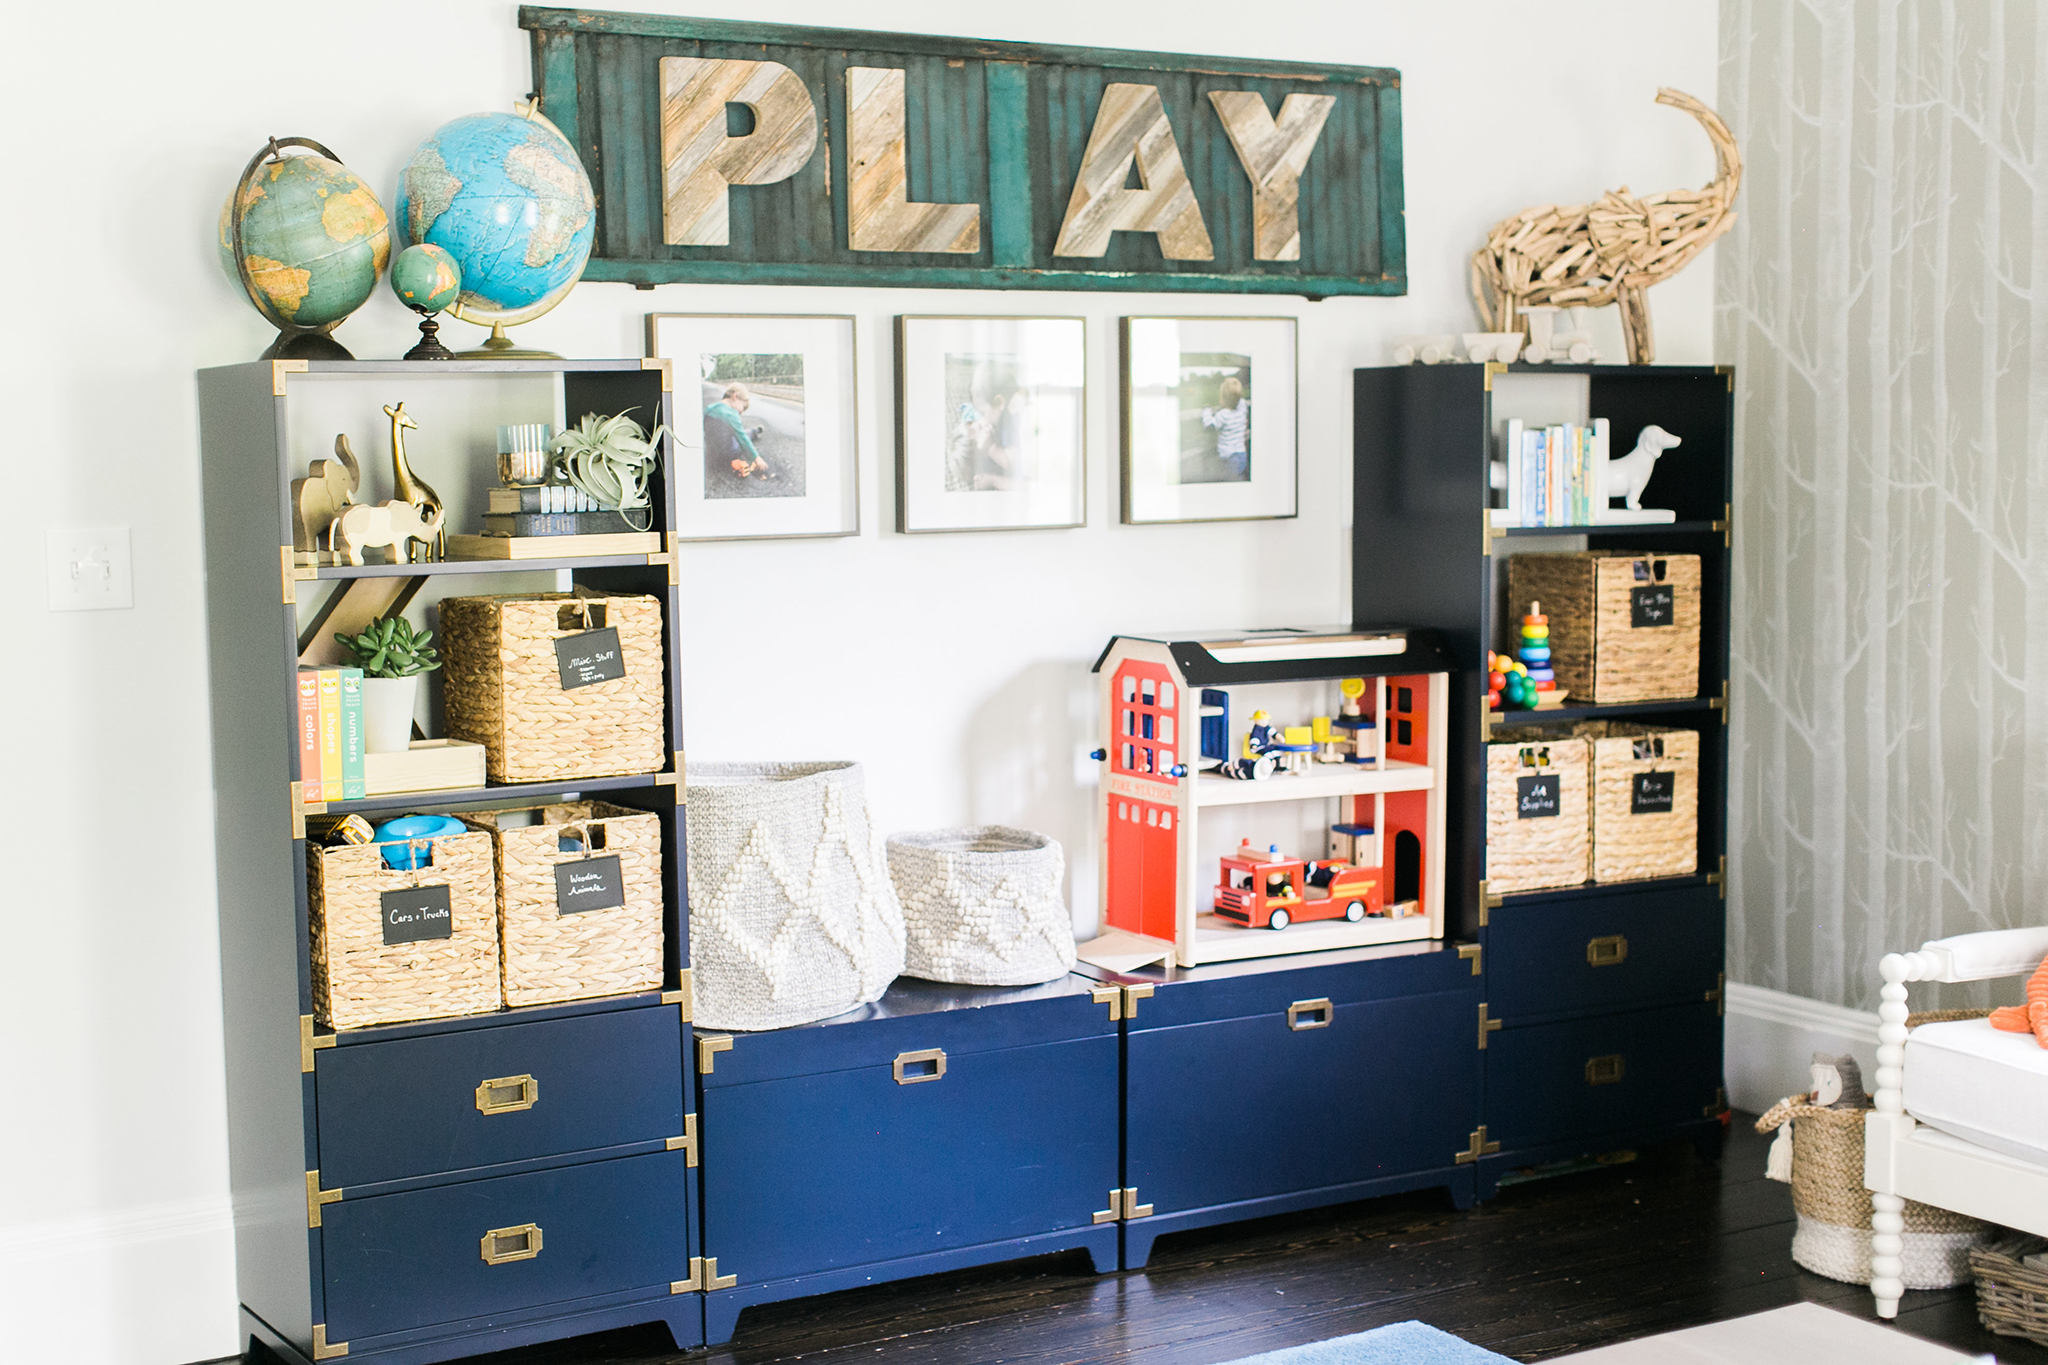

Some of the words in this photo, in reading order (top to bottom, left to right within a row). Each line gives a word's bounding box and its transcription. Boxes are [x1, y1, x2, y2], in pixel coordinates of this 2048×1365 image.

[659, 56, 1337, 260] PLAY
[305, 714, 316, 751] colors
[325, 712, 337, 754] shapes
[348, 711, 359, 763] numbers
[390, 909, 413, 925] Cars
[419, 906, 450, 920] Trucks
